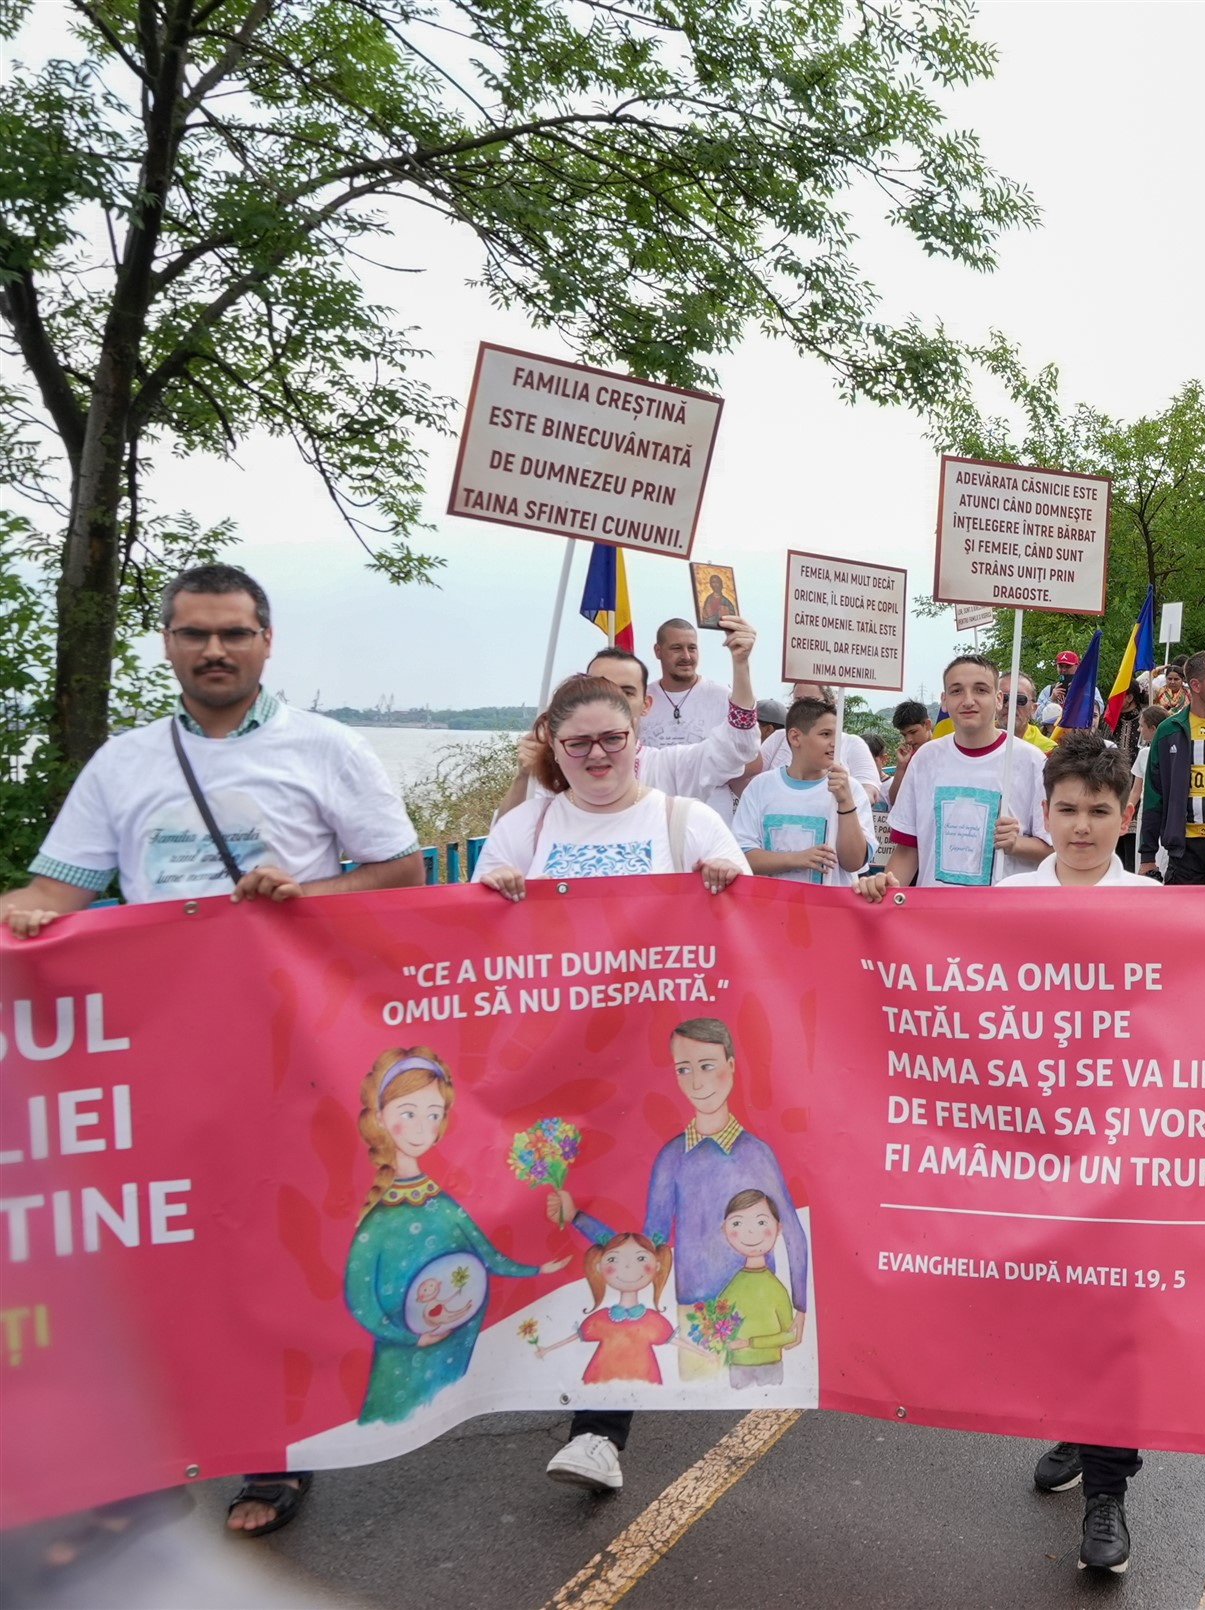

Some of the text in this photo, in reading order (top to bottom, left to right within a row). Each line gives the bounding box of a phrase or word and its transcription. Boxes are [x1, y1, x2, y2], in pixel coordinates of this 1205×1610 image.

[513, 367, 686, 424] FAMILIA CREȘTINĂ
[489, 406, 693, 468] ESTE BINECUVÂNTATĂ
[489, 450, 677, 506] DE DUMNEZEU PRIN
[956, 471, 1098, 500] ADEVĂRATA CĂSNICIE ESTE
[463, 488, 684, 549] TAINA SFINTEI CUNUNII.
[959, 494, 1000, 510] ATUNCI
[1003, 497, 1032, 514] CÂND
[1022, 520, 1054, 538] ÎNTRE
[1057, 525, 1096, 542] BĂRBAT
[978, 540, 1021, 558] FEMEIE,
[1024, 542, 1052, 560] CÂND
[1056, 548, 1084, 562] SUNT
[800, 565, 832, 583] FEMEIA,
[834, 571, 848, 582] MAI
[851, 574, 871, 586] MULT
[971, 560, 1014, 578] STRÂNS
[1050, 569, 1075, 582] PRIN
[794, 588, 829, 606] ORICINE,
[840, 596, 864, 610] EDUCĂ
[867, 600, 876, 611] PE
[878, 601, 899, 614] COPIL
[993, 585, 1052, 602] DRAGOSTE.
[794, 611, 896, 636] CĂTRE OMENIE. TATĂL ESTE
[791, 637, 898, 660] CREIERUL, DAR FEMEIA ESTE
[812, 663, 877, 680] INIMA OMENIRII.
[456, 959, 477, 984] A
[484, 954, 553, 981] UNIT
[561, 945, 716, 977] DUMNEZEU
[926, 957, 1008, 992] LĂSA
[1017, 963, 1114, 992] OMUL
[1124, 963, 1163, 991] PE
[382, 996, 467, 1026] OMUL
[474, 986, 513, 1017] SĂ
[519, 988, 560, 1013] NU
[882, 1004, 970, 1040] TATĂL
[978, 1005, 1044, 1040] SĂU
[1092, 1010, 1131, 1038] PE
[887, 1050, 980, 1086] MAMA
[987, 1058, 1028, 1088] SA
[1076, 1058, 1114, 1087] SE
[1122, 1058, 1164, 1088] VA
[887, 1096, 928, 1126] DE
[936, 1101, 1046, 1135] FEMEIA
[1054, 1106, 1096, 1136] SA
[884, 1143, 910, 1172] FI
[918, 1142, 1071, 1183] AMÂNDOI
[1079, 1156, 1122, 1186] UN
[878, 1251, 1186, 1292] EVANGHELIA DUPĂ MATEI 19, 5
